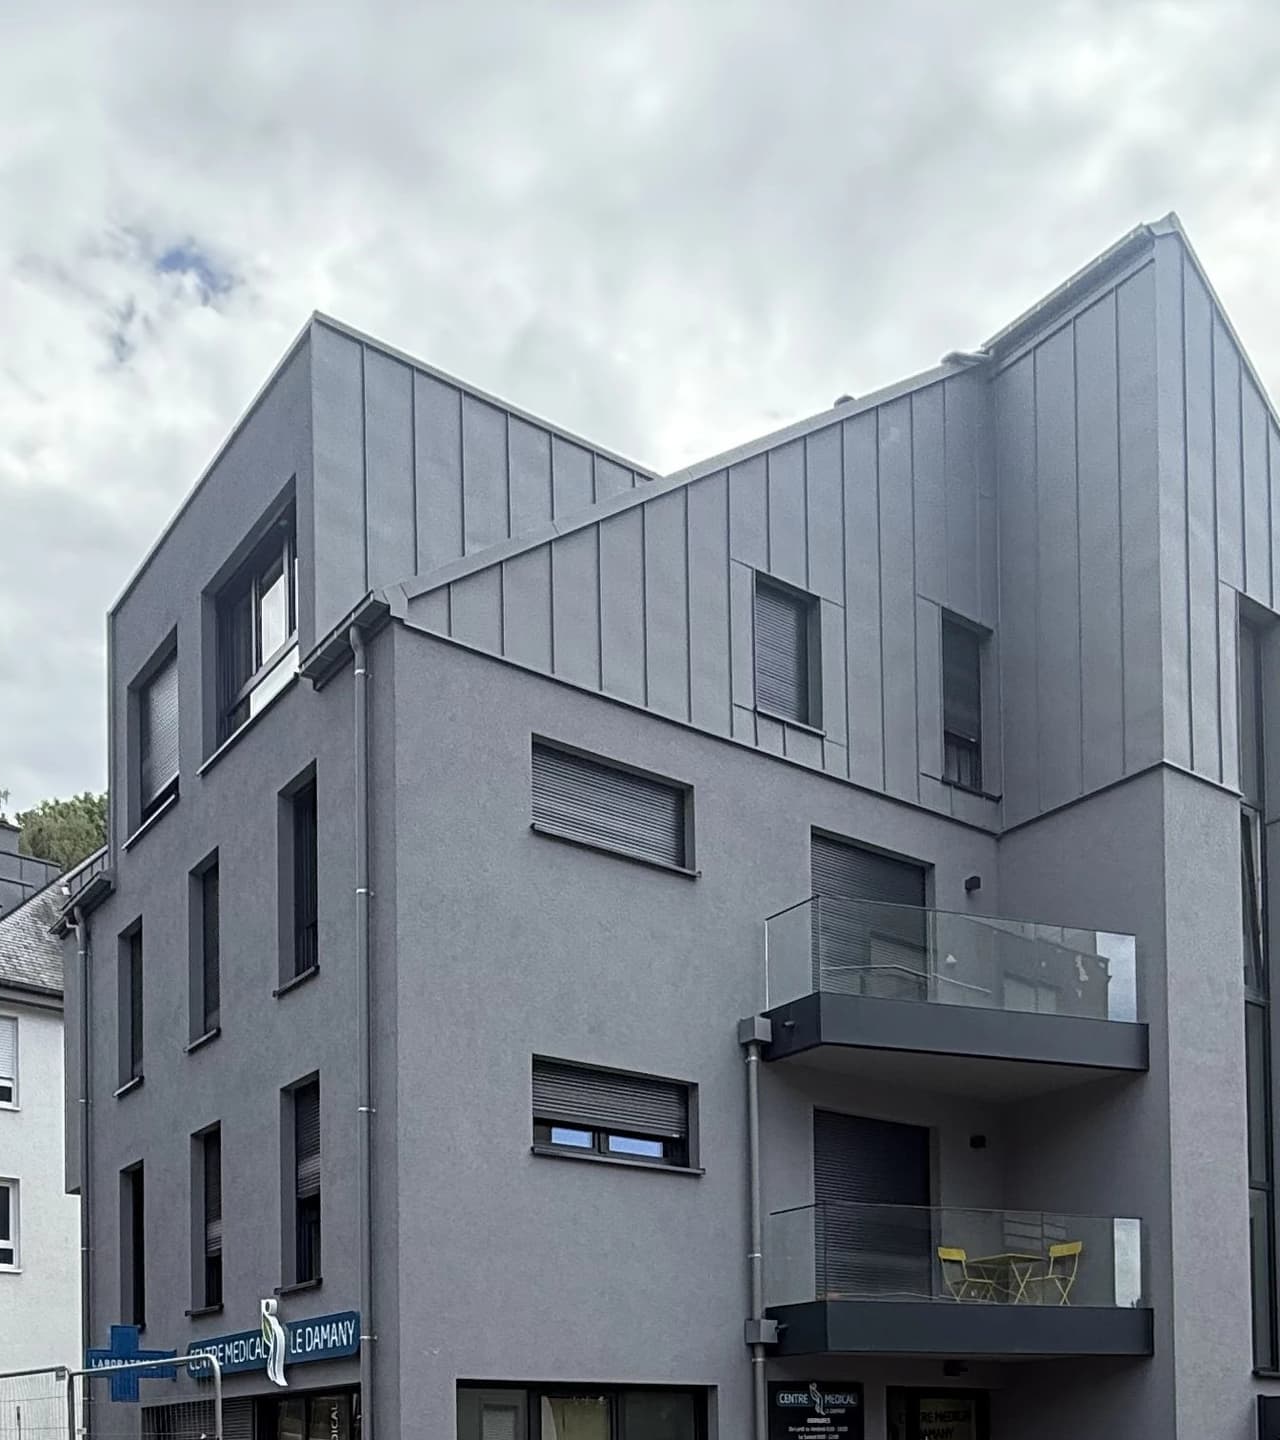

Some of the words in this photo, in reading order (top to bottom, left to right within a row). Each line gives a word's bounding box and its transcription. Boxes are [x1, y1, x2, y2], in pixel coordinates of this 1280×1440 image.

[225, 1336, 267, 1364] MEDICAL
[291, 1329, 303, 1353] LE
[306, 1320, 355, 1351] DAMANY
[779, 1393, 808, 1404] CENTRE
[824, 1393, 856, 1404] MEDICAL
